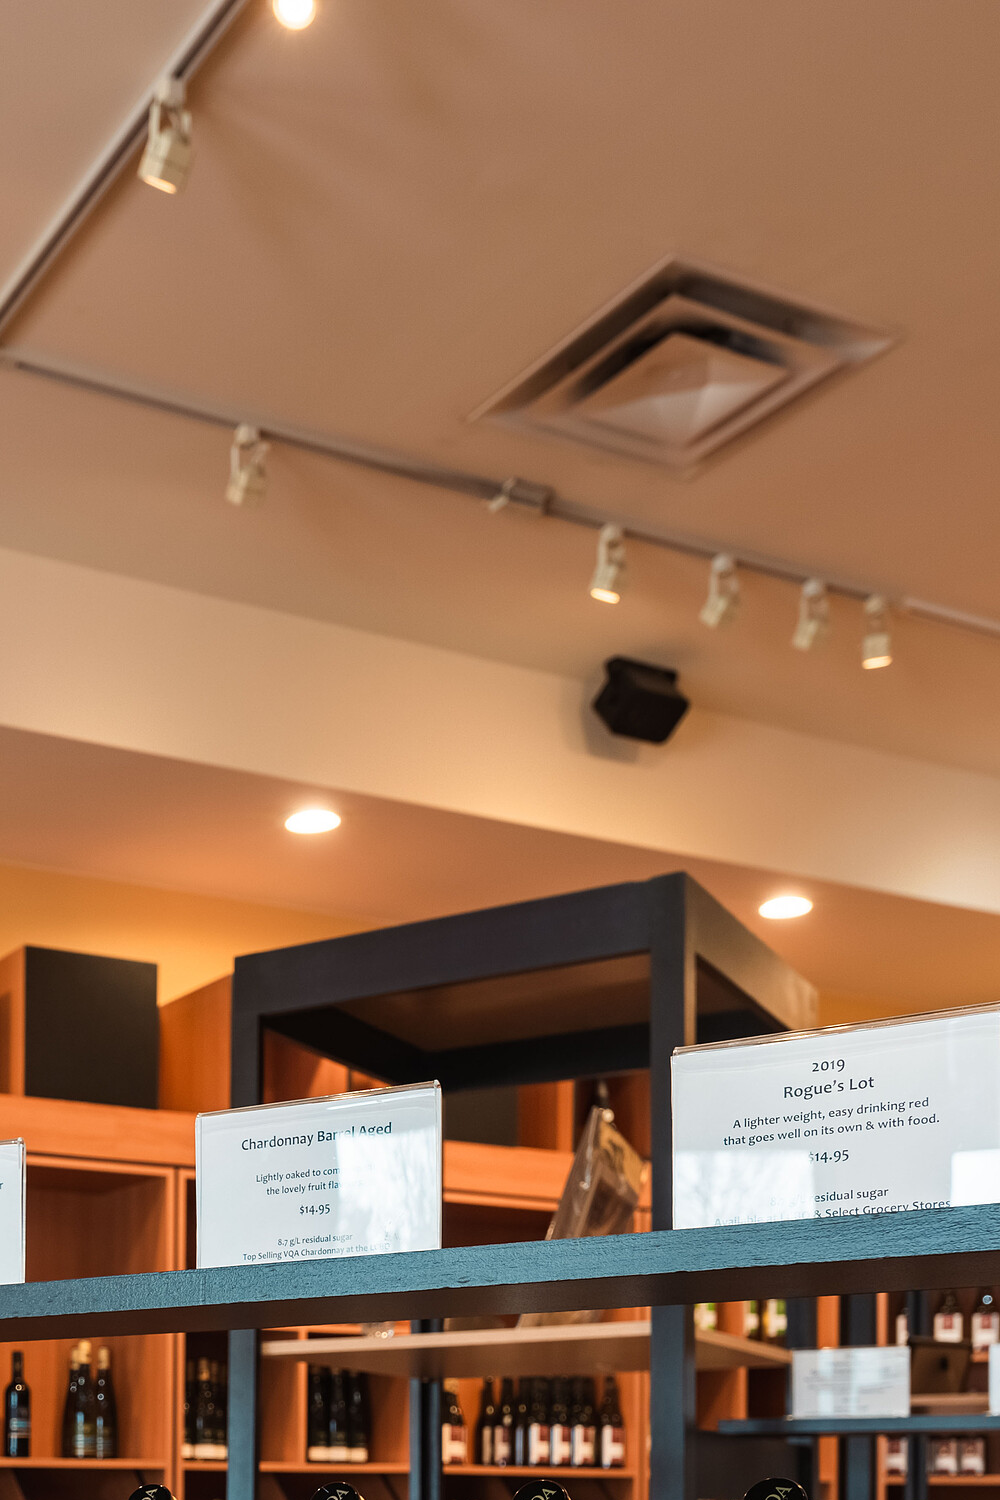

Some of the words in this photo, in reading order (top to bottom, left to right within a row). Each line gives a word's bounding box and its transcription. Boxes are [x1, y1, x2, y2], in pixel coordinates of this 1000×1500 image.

[811, 1059, 845, 1072] 2019
[783, 1079, 844, 1100] Rogue's
[849, 1076, 875, 1091] Lot
[733, 1119, 741, 1129] A
[744, 1114, 780, 1130] lighter
[783, 1110, 826, 1124] weight,
[828, 1107, 854, 1118] easy
[856, 1101, 906, 1115] drinking
[908, 1097, 929, 1108] red
[723, 1136, 746, 1146] that
[748, 1134, 775, 1146] goes
[777, 1129, 801, 1140] well
[803, 1128, 818, 1137] on
[820, 1125, 834, 1135] its
[837, 1123, 863, 1133] own
[865, 1121, 875, 1131] &
[877, 1117, 905, 1129] with
[907, 1113, 940, 1126] food.
[241, 1133, 314, 1150] Chardonnay
[808, 1149, 849, 1164] $14.95
[256, 1171, 284, 1185] Lightly
[285, 1169, 311, 1180] oaked
[312, 1169, 321, 1177] to
[266, 1187, 280, 1195] the
[281, 1184, 306, 1195] lovely
[308, 1182, 327, 1191] fruit
[813, 1189, 853, 1203] esidual
[856, 1188, 889, 1201] sugar
[299, 1204, 331, 1215] $14.95
[825, 1207, 859, 1217] Select
[862, 1203, 909, 1215] Grocery
[912, 1199, 951, 1210] Stores
[277, 1239, 288, 1248] 8.7
[289, 1237, 301, 1247] g/L
[302, 1234, 331, 1244] residual
[333, 1233, 353, 1243] sugar
[243, 1253, 257, 1262] Top
[258, 1251, 282, 1261] Selling
[283, 1249, 300, 1259] VQA
[301, 1246, 345, 1257] Chardonnay
